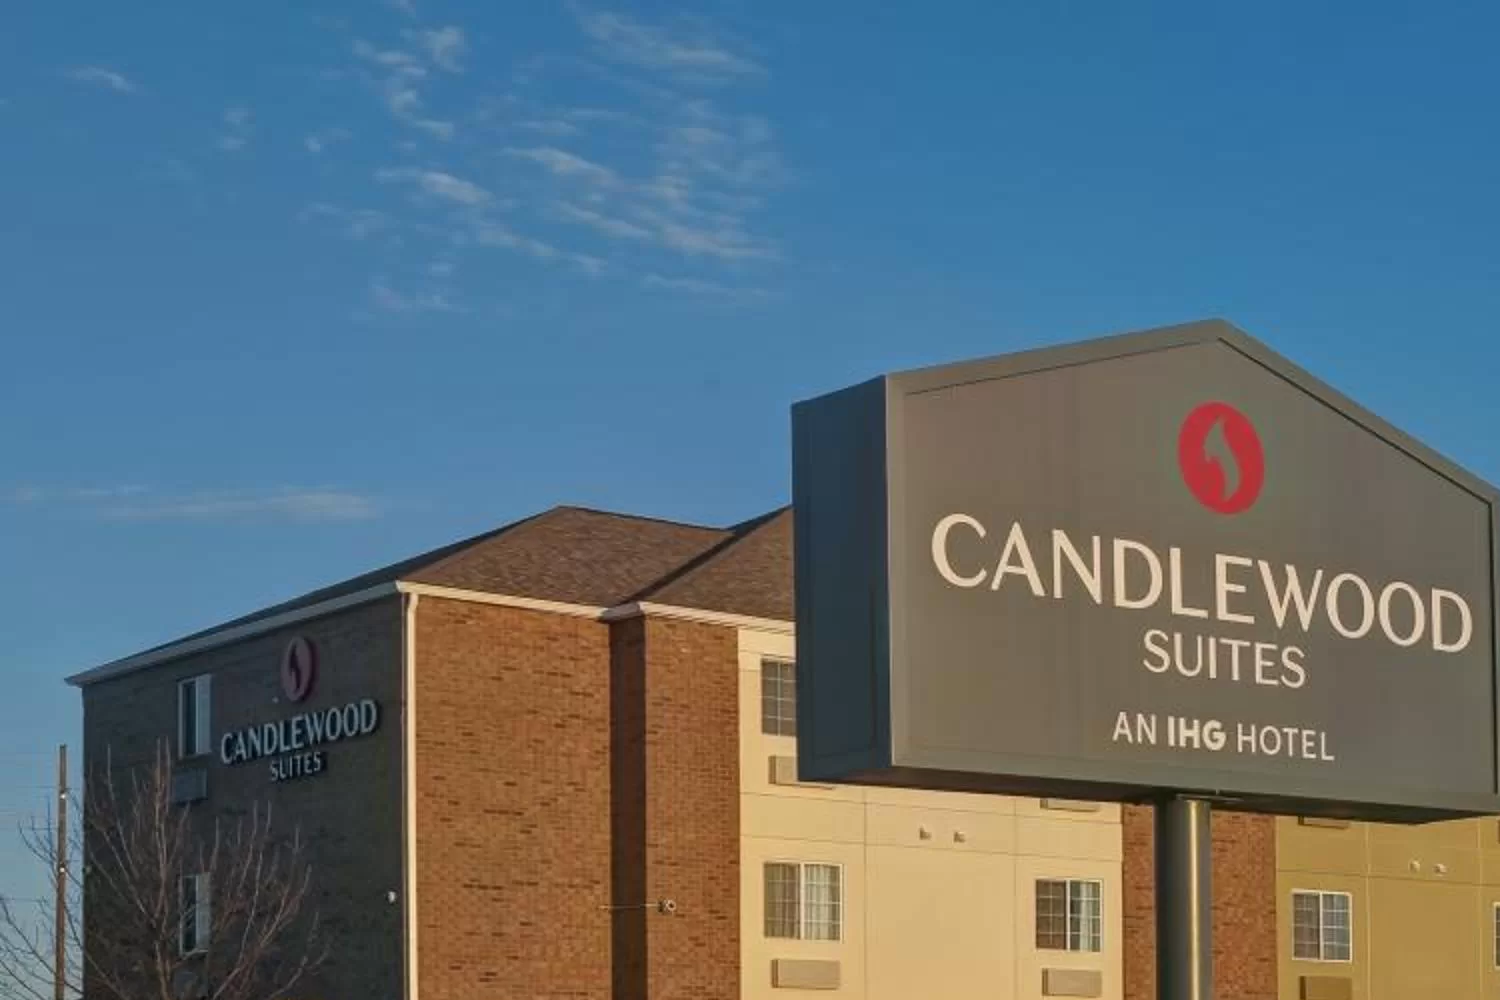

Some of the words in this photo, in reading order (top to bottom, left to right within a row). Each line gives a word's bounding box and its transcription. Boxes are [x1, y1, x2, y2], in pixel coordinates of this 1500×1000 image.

[931, 513, 1473, 653] CANDLEWOOD
[1142, 629, 1306, 688] SUITES
[221, 699, 377, 764] CANDLEWOOD
[1112, 711, 1157, 746] AN
[1167, 716, 1226, 751] IHG
[1237, 724, 1335, 761] HOTEL
[270, 752, 321, 782] SUITES
